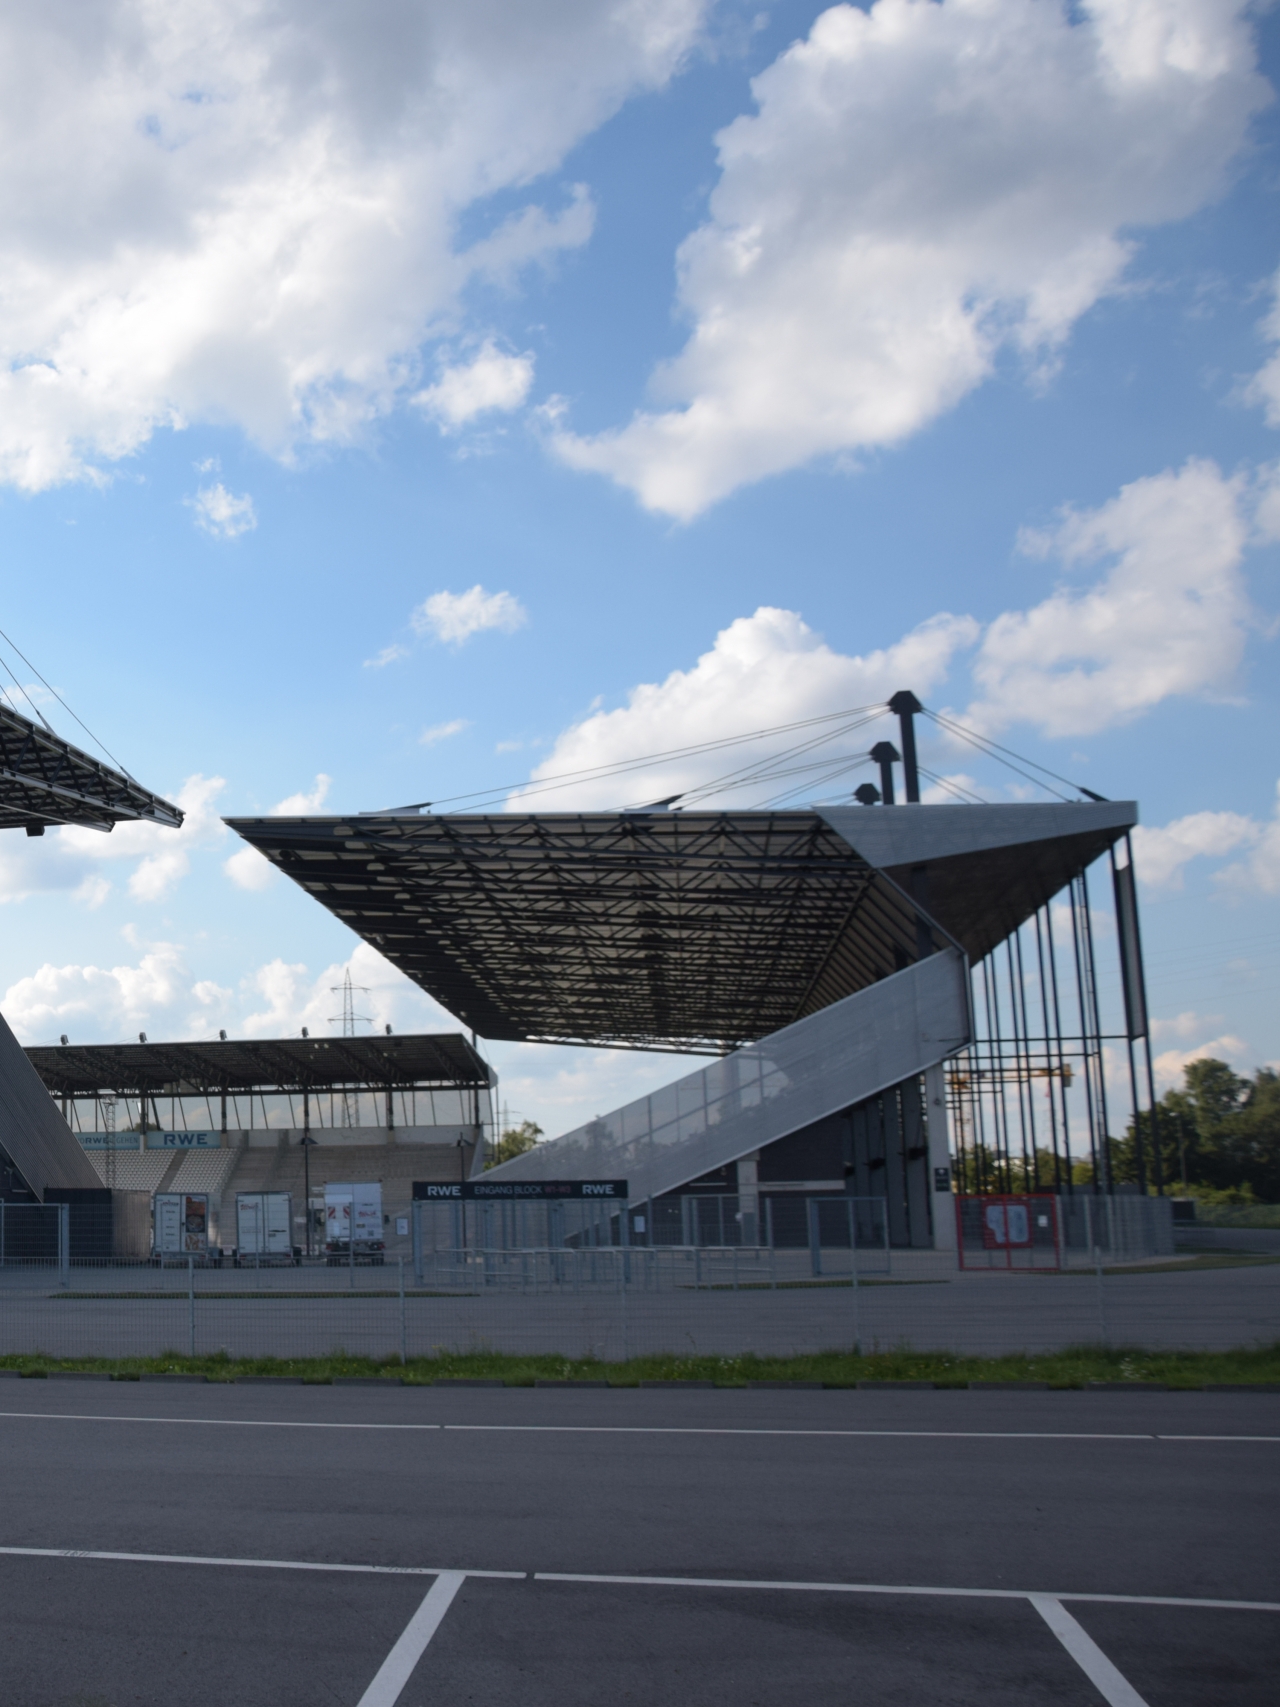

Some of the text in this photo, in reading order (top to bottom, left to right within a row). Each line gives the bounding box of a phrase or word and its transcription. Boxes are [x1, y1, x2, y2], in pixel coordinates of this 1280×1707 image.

[163, 1133, 208, 1145] RWE
[427, 1185, 462, 1196] RWE
[474, 1186, 513, 1195] EINGANG
[514, 1185, 543, 1194] BLOCK
[582, 1184, 615, 1195] RWE
